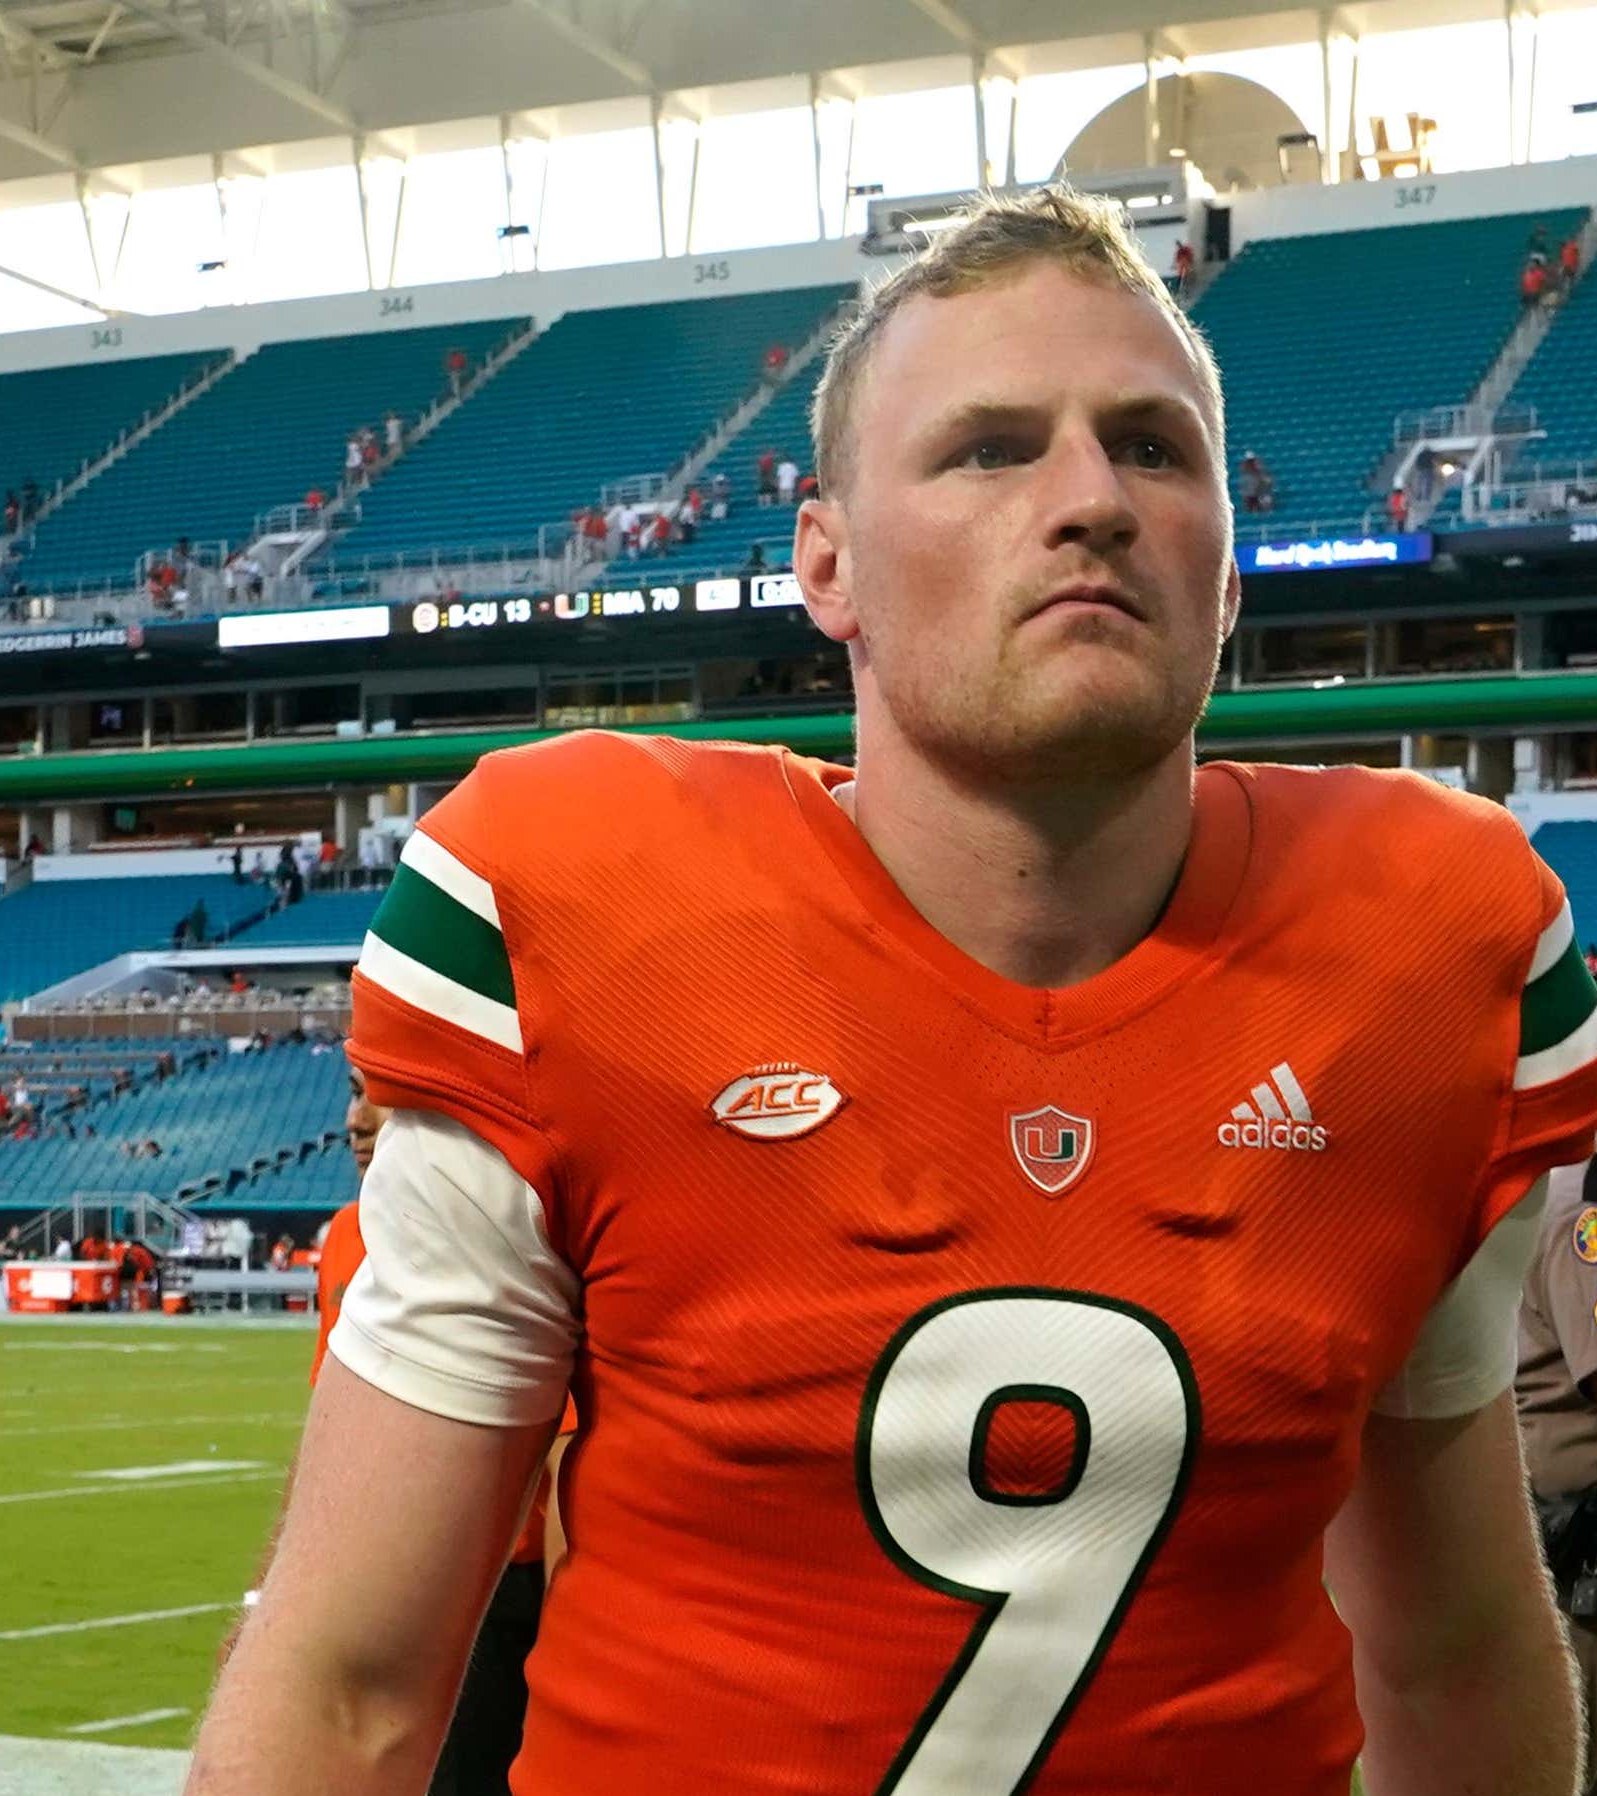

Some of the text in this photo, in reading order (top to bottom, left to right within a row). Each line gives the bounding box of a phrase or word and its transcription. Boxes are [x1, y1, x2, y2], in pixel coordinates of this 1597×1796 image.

[1394, 185, 1436, 209] 347
[694, 261, 730, 284] 345
[379, 295, 414, 317] 344
[90, 329, 122, 350] 343
[504, 598, 531, 622] 13
[650, 587, 679, 611] 70
[727, 1077, 826, 1114] ACC
[1025, 1127, 1075, 1163] U
[1217, 1116, 1326, 1150] adidas
